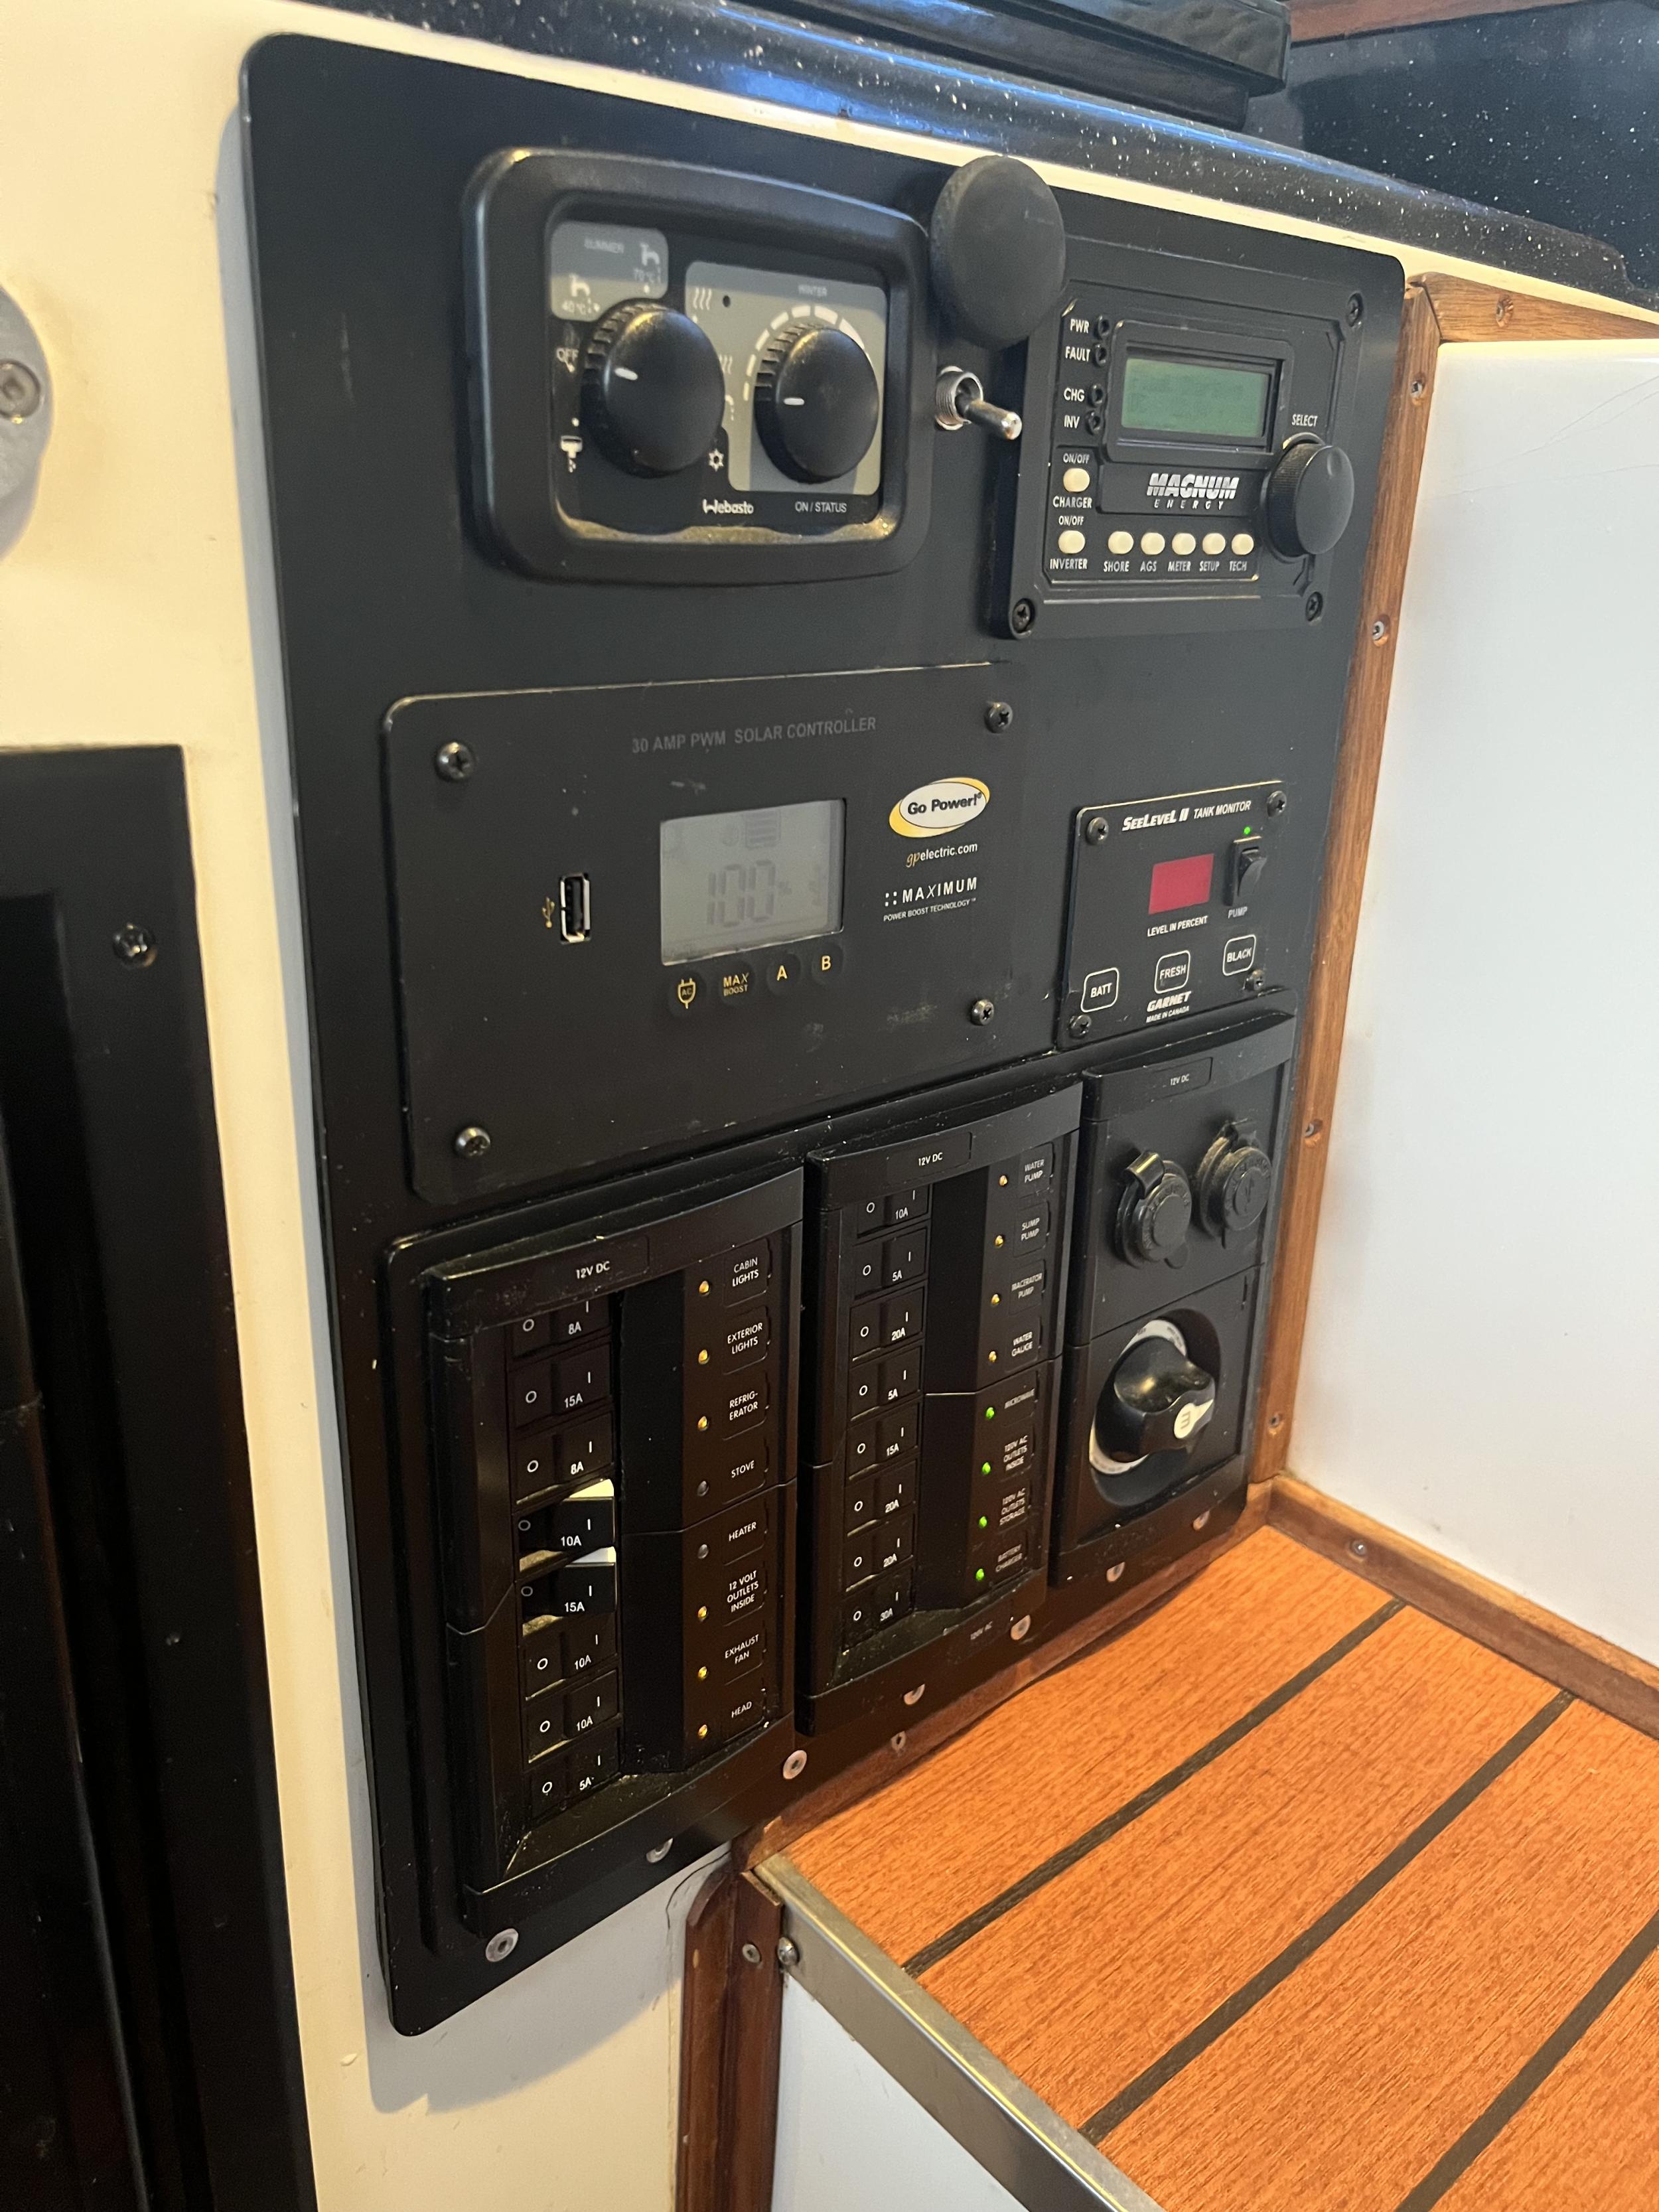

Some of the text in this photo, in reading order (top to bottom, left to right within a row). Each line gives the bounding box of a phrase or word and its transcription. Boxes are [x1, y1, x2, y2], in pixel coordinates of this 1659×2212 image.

[1070, 319, 1090, 333] PWR
[1065, 346, 1090, 362] FAULT
[1064, 388, 1084, 402] CHG
[1064, 416, 1080, 429] INV
[1291, 414, 1318, 427] SELECT
[1063, 453, 1090, 464] ON/OFF
[1147, 473, 1240, 500] MAGNUM
[702, 498, 754, 515] Webasto
[815, 502, 847, 513] STATUS
[1052, 496, 1092, 509] CHARGER
[1059, 515, 1084, 526] ON/OFF
[1050, 559, 1088, 570] INVERTER
[1104, 561, 1129, 572] SHORE
[1140, 561, 1157, 572] AGS
[1168, 561, 1191, 572] METER
[1199, 561, 1220, 572] SETUP
[1229, 561, 1248, 571] TECH
[632, 717, 876, 753] 30 AMP PWM SOLAR CONTROLLER
[908, 802, 926, 814] Go
[1194, 805, 1214, 819] TANK
[1215, 800, 1251, 816] MONITOR
[906, 844, 977, 867] gpelectric.com
[902, 877, 977, 903] MAXIMUM
[883, 911, 906, 921] POWER
[908, 907, 929, 917] BOOST
[930, 899, 970, 913] TECHNOLOGY
[1228, 907, 1248, 919] PUMP
[1147, 915, 1208, 936] LEVEL IN PERCENT
[1226, 947, 1252, 963] BLACK
[822, 955, 831, 971] B
[777, 966, 787, 980] A
[1159, 964, 1187, 980] FRESH
[723, 973, 749, 988] MAX
[724, 985, 748, 996] BOOST
[1090, 983, 1112, 998] BATT
[1147, 991, 1192, 1012] GARNET
[1146, 1005, 1189, 1023] MADE IN CANADA
[1170, 1073, 1189, 1086] 12V DC
[918, 1152, 943, 1166] 12V DC
[1025, 1159, 1045, 1172] WATER
[1025, 1170, 1043, 1183] PUMP
[895, 1207, 908, 1219] 10A
[1022, 1218, 1040, 1230] SUMP
[1021, 1228, 1039, 1241] PUMP
[576, 1261, 610, 1280] 12V DC
[733, 1257, 758, 1273] CABIN
[732, 1270, 759, 1287] LIGHTS
[892, 1270, 902, 1282] 5A
[1018, 1286, 1035, 1299] PUMP
[569, 1321, 582, 1335] 8A
[727, 1322, 763, 1345] EXTERIOR
[891, 1327, 906, 1341] 20A
[1013, 1331, 1033, 1346] WATER
[731, 1337, 758, 1355] LIGHTS
[564, 1392, 583, 1408] 15A
[729, 1390, 758, 1408] REFRIG-
[888, 1388, 898, 1400] 5A
[729, 1401, 758, 1421] ERATOR
[886, 1443, 899, 1456] 15A
[570, 1461, 584, 1475] 8A
[731, 1460, 755, 1478] STOVE
[885, 1499, 899, 1513] 20A
[729, 1521, 757, 1542] HEATER
[560, 1536, 581, 1546] 10A
[729, 1570, 757, 1591] 12 VOLT
[727, 1580, 759, 1603] OUTLETS
[564, 1601, 585, 1613] 15A
[731, 1595, 755, 1613] INSIDE
[725, 1634, 759, 1659] EXHAUST
[574, 1655, 591, 1670] 10A
[735, 1651, 750, 1664] FAN
[731, 1701, 752, 1718] HEAD
[576, 1716, 593, 1732] 10A
[579, 1777, 592, 1791] 5A
